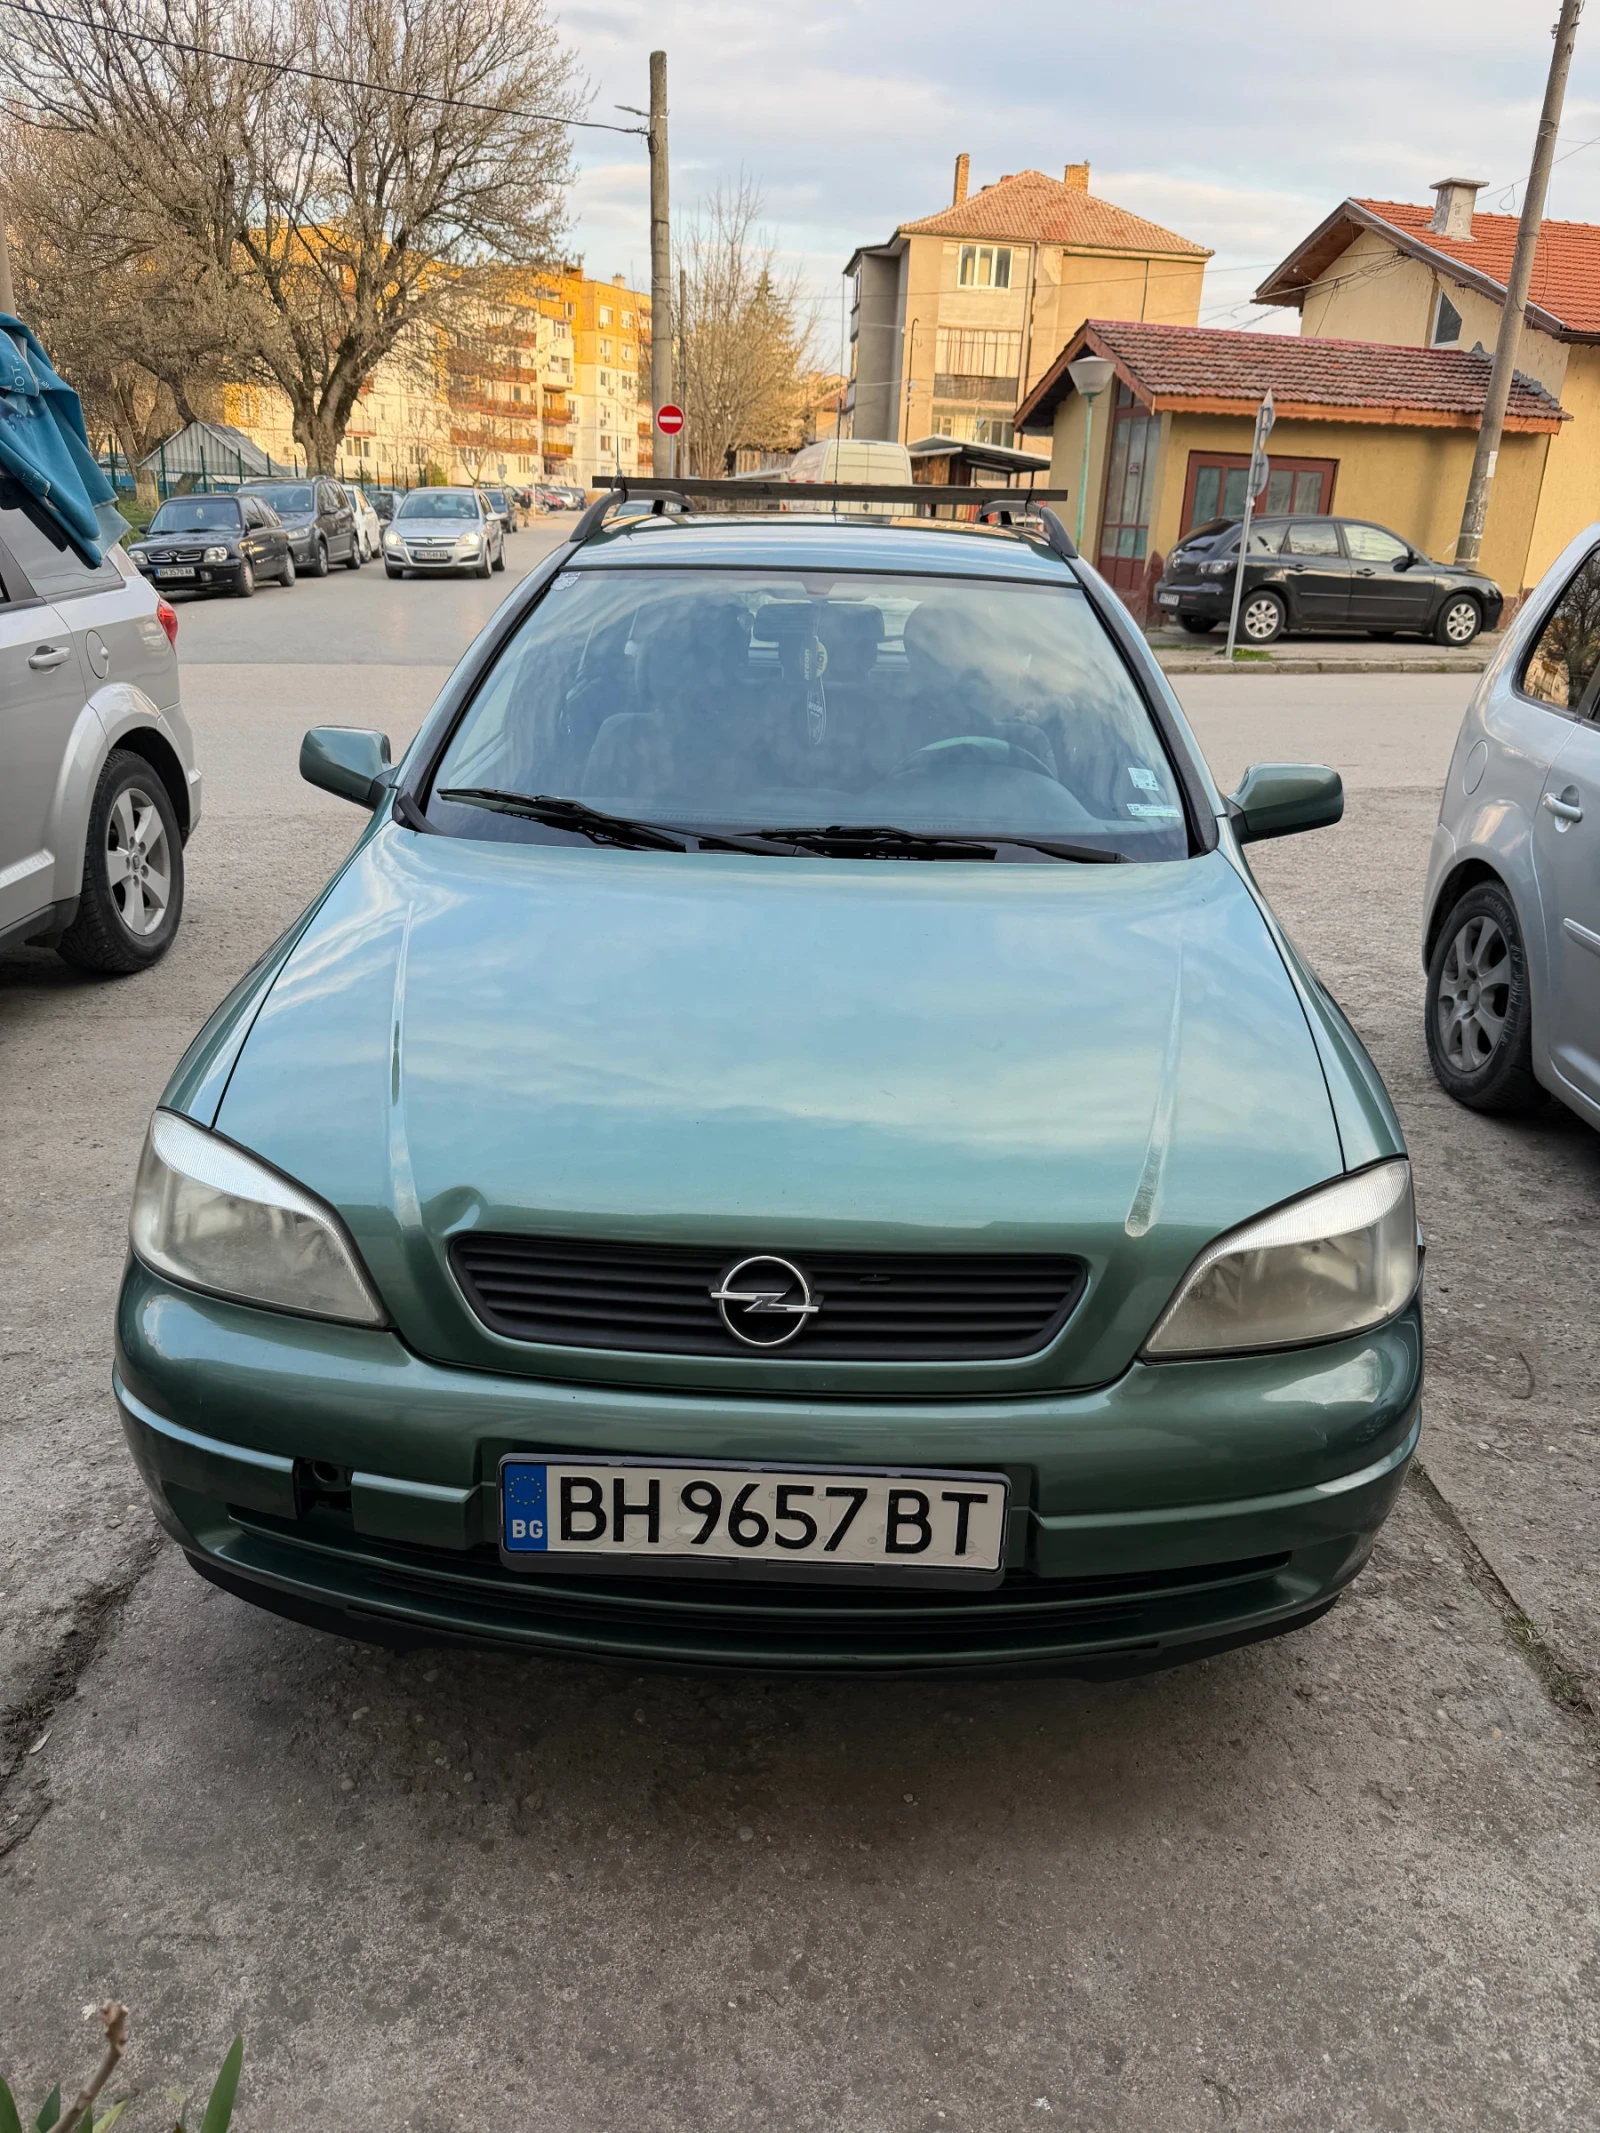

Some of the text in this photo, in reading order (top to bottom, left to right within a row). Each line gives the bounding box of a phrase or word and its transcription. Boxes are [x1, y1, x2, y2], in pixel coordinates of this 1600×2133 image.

[512, 1519, 544, 1538] BG
[559, 1475, 989, 1556] BH 9657 BT
